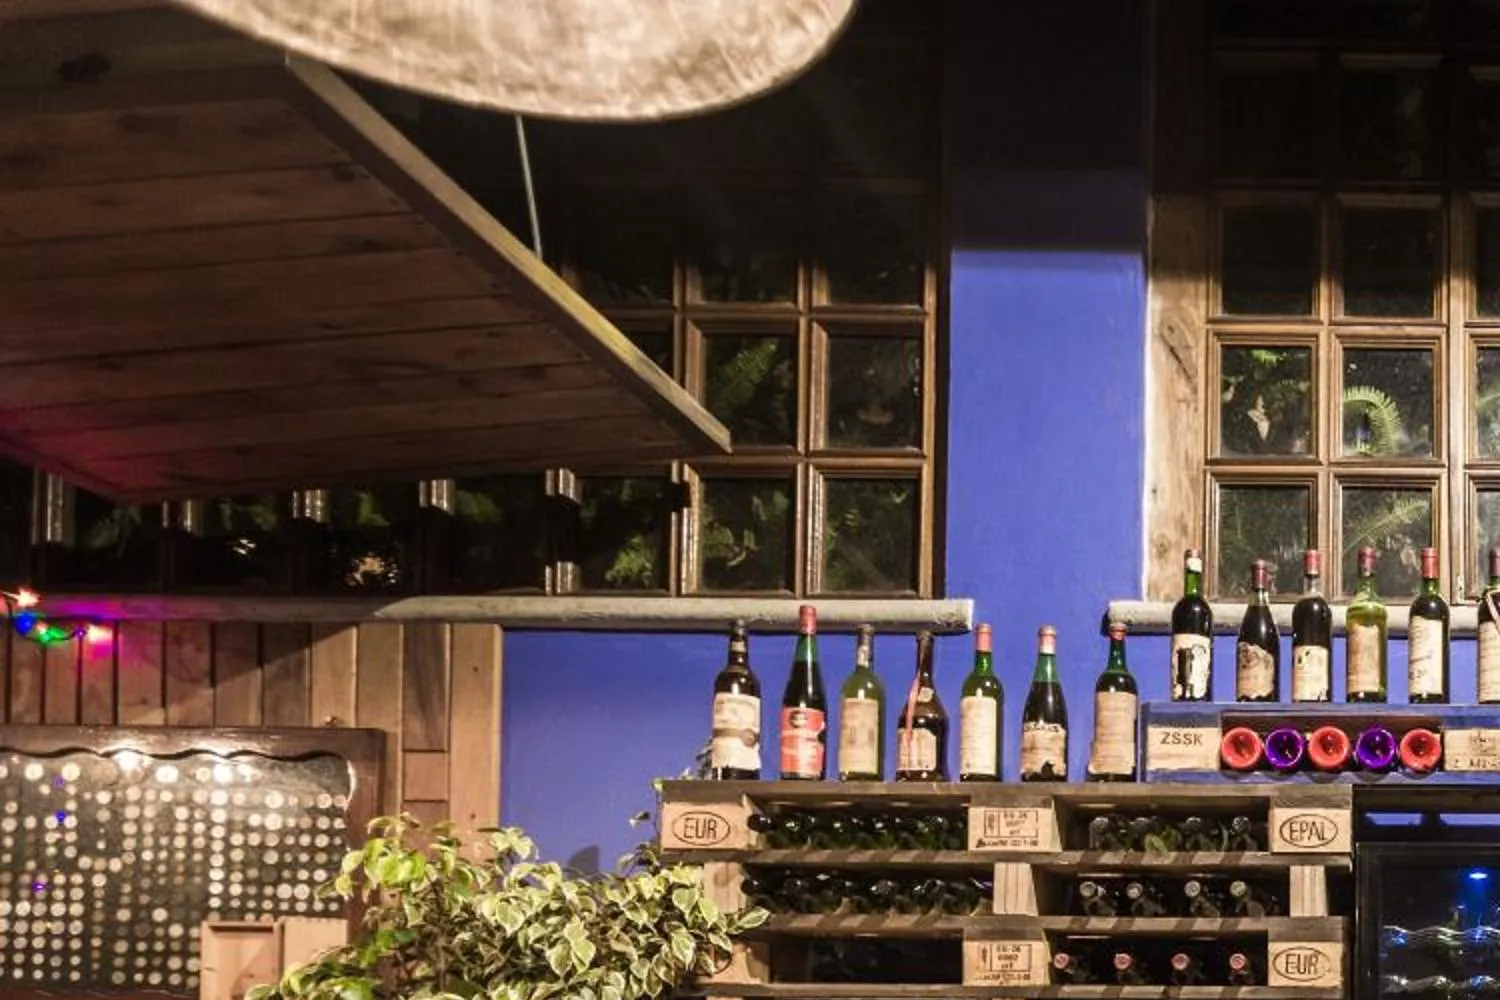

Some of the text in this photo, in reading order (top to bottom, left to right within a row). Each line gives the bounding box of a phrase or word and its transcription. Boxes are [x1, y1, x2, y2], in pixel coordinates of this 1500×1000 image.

[1160, 731, 1203, 746] ZSSK
[683, 817, 718, 840] EUR
[1289, 821, 1329, 841] EPAL
[1284, 954, 1319, 975] EUR
